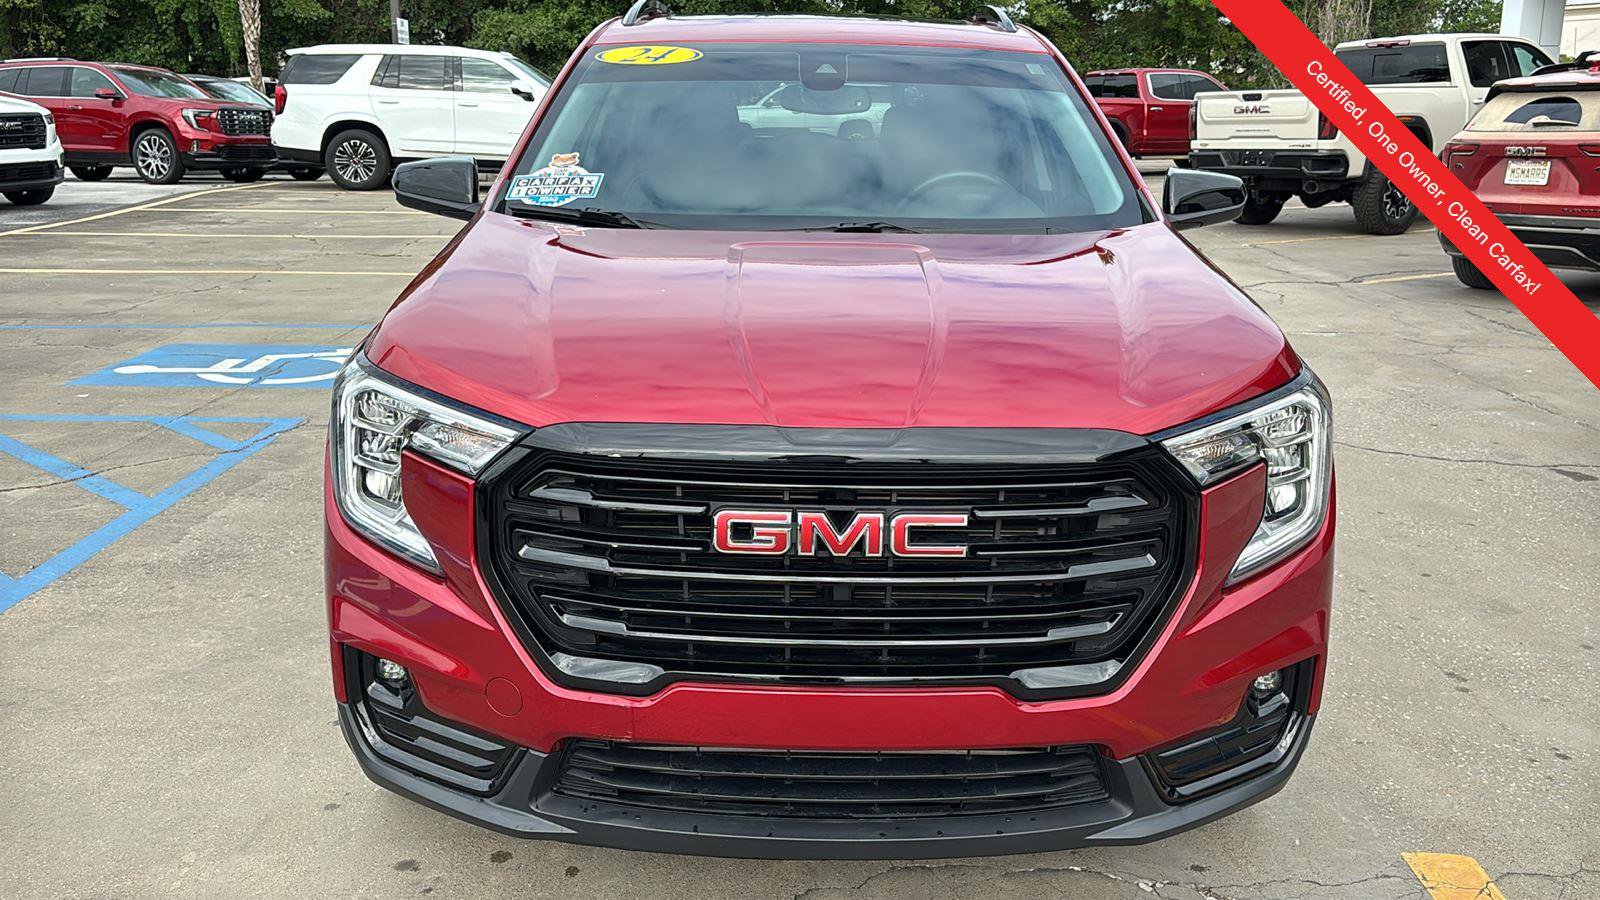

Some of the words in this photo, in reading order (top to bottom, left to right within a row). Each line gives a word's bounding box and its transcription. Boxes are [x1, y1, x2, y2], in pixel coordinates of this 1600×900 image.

[619, 47, 679, 62] 24
[1233, 105, 1271, 115] GMC
[1504, 146, 1547, 156] GMC
[517, 176, 595, 187] CARFAX
[527, 186, 592, 195] OWNER
[713, 510, 968, 557] GMC
